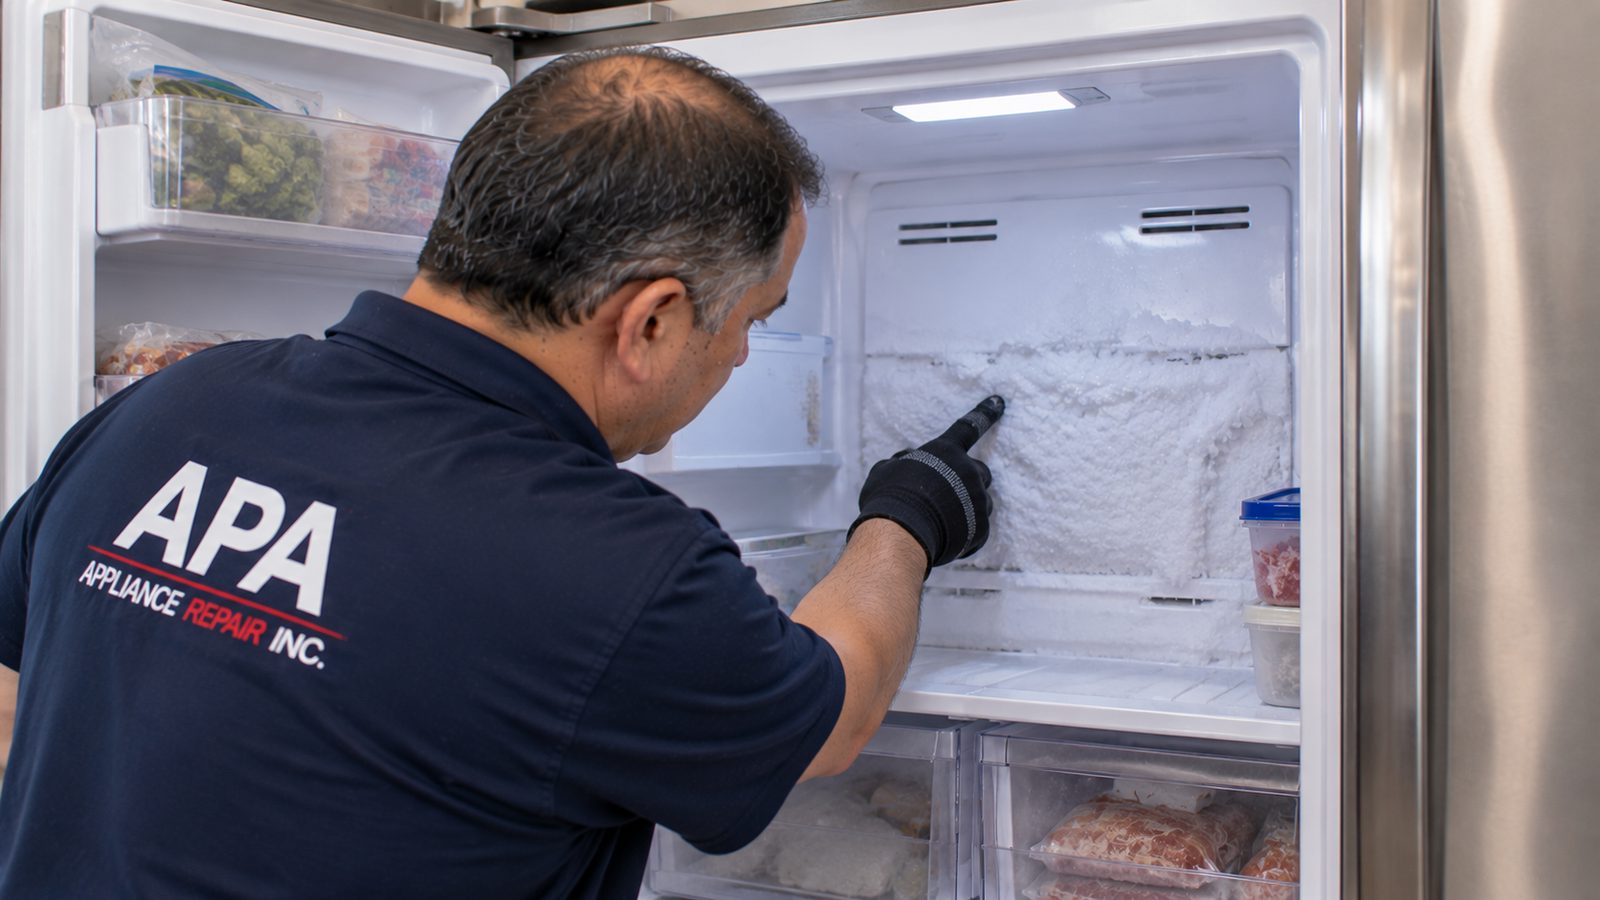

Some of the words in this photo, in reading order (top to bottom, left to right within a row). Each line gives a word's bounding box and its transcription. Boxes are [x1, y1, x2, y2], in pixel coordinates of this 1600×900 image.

[112, 460, 337, 617] APA
[78, 560, 185, 617] APPLIANCE
[182, 597, 268, 646] REPAIR
[268, 626, 326, 670] INC.
